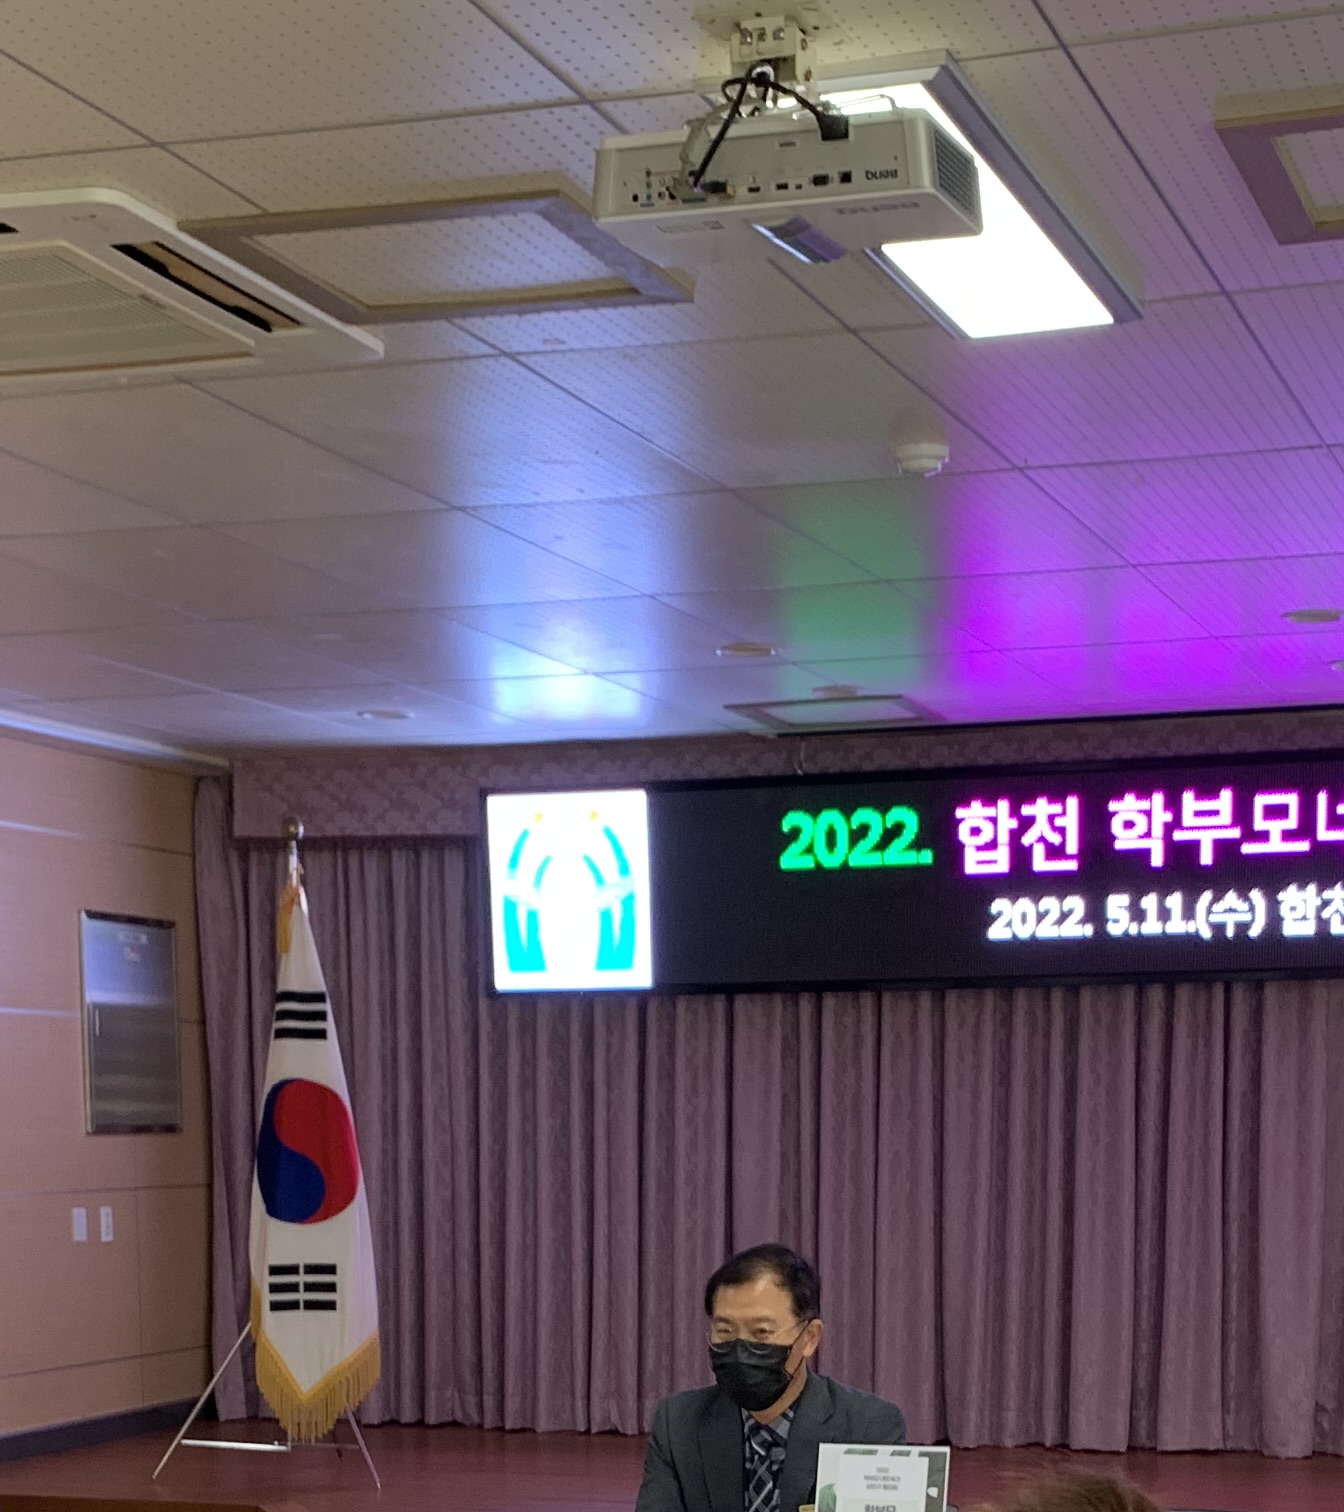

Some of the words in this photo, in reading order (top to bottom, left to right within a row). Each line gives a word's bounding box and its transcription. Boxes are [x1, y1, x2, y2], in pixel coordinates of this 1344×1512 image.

[779, 807, 933, 870] 2022.
[955, 795, 1080, 875] 합천
[987, 895, 1094, 940] 2022.
[1106, 888, 1267, 939] 5.11.(수)
